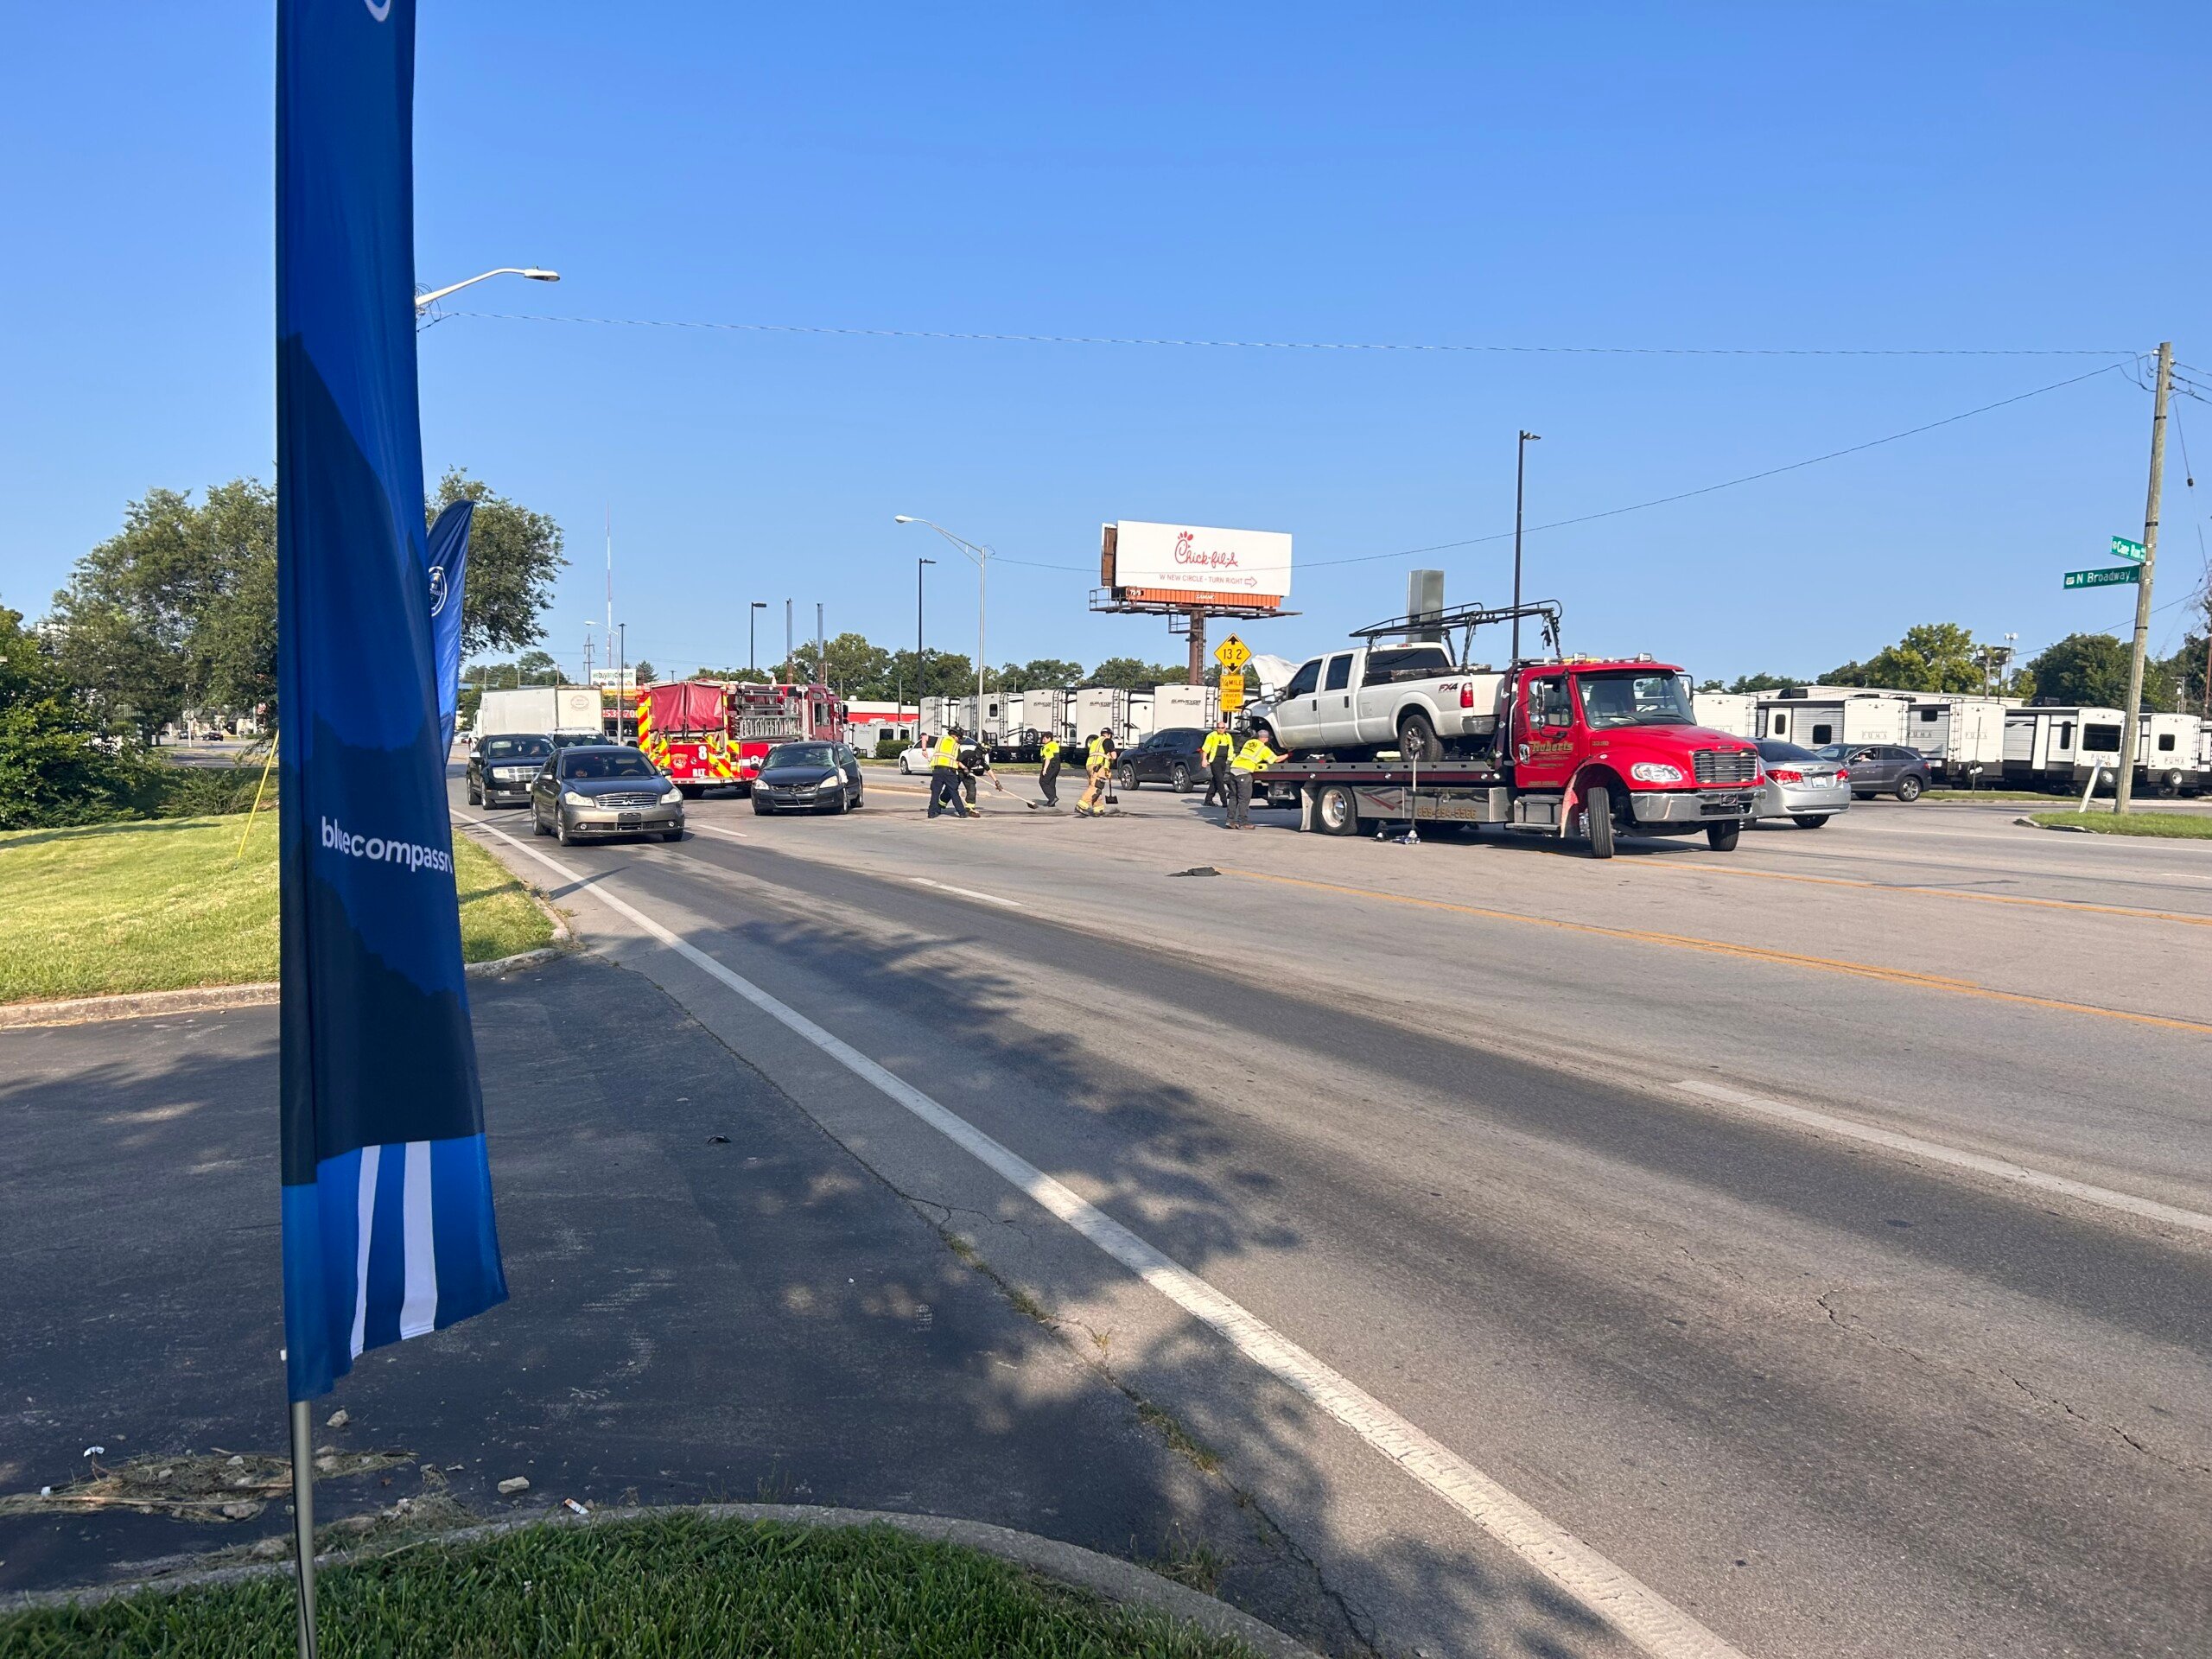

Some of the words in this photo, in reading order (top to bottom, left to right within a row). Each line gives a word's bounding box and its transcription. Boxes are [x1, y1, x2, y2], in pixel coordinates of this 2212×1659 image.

[1175, 538, 1239, 569] Chick-fil-A
[2076, 574, 2083, 584] N
[2088, 571, 2130, 582] Broadway
[1439, 683, 1459, 692] FX4
[698, 746, 708, 760] 8
[1528, 741, 1573, 753] Roberts
